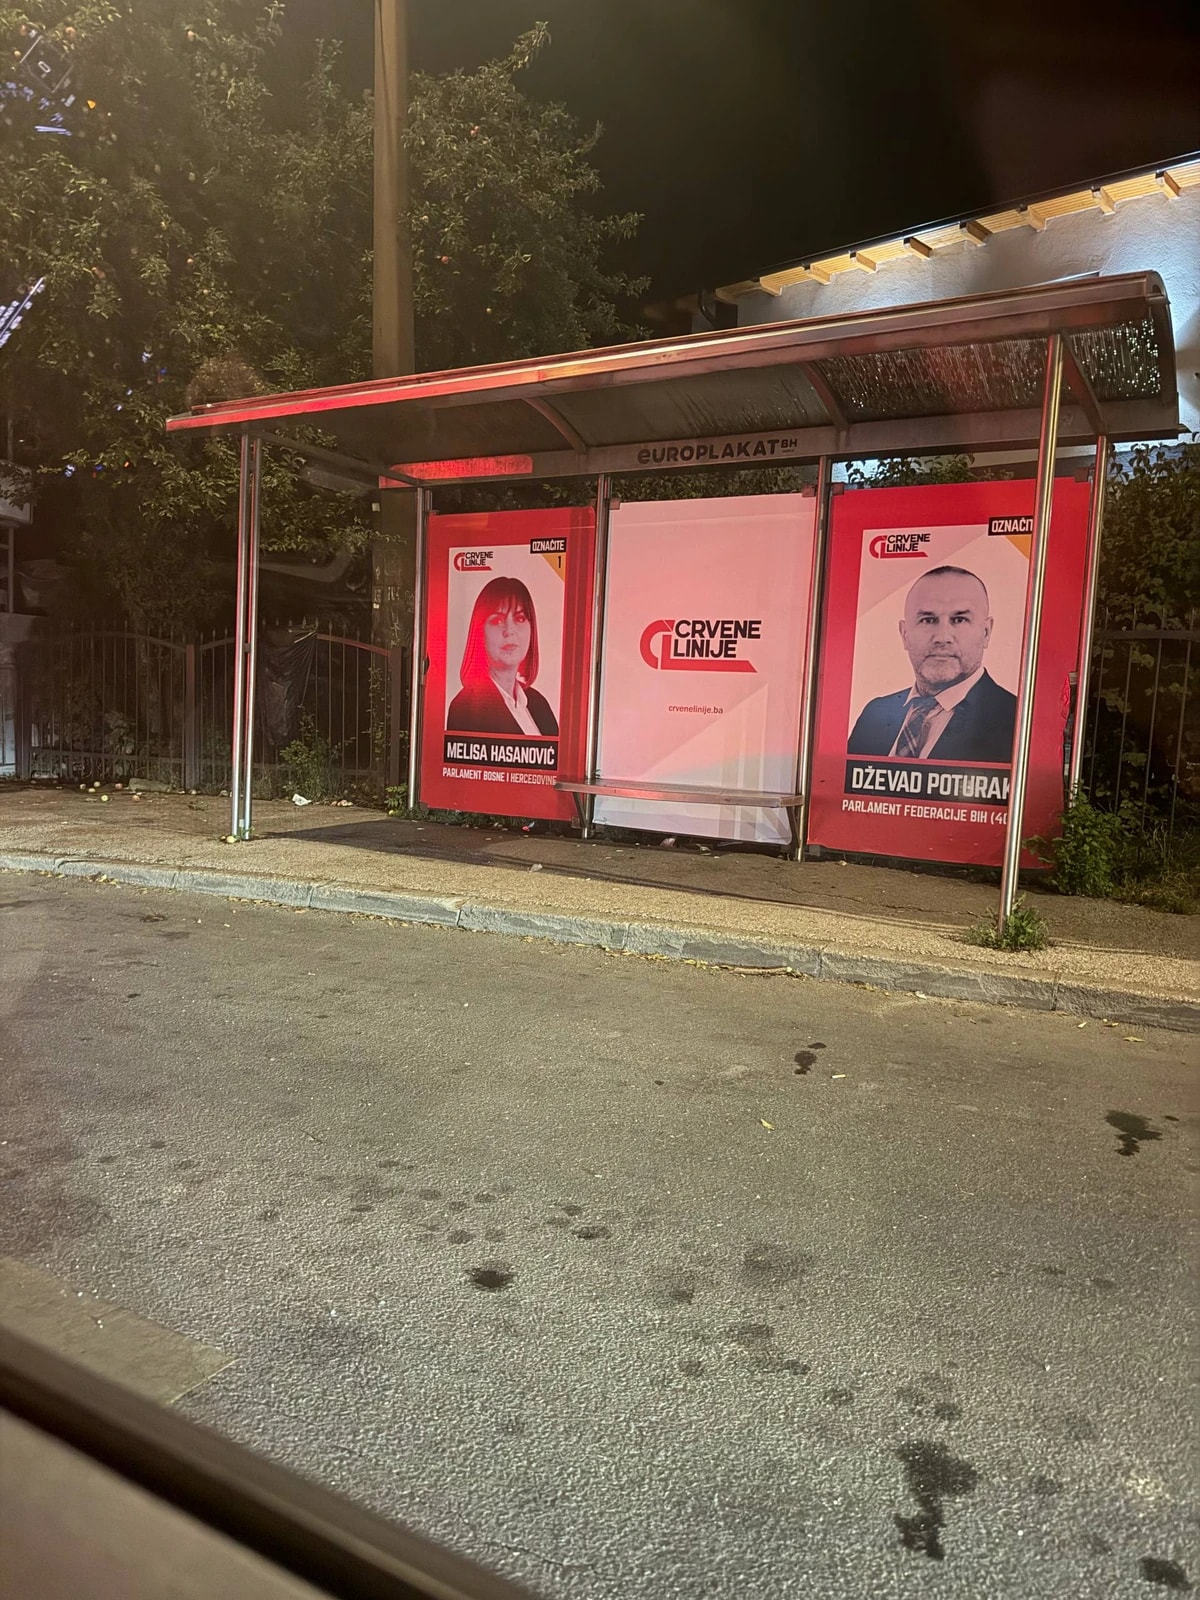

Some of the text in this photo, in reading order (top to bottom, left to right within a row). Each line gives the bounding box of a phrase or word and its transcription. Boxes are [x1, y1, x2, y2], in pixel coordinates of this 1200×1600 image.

[780, 438, 798, 449] BH
[991, 517, 1033, 533] OZNAČIT
[532, 539, 565, 551] OZNAČITE
[887, 533, 931, 543] CRVENE
[886, 542, 919, 552] LINIJE
[465, 551, 494, 559] CRVENE
[557, 556, 562, 569] 1
[675, 619, 762, 639] CRVENE
[673, 639, 737, 658] LINIJE
[668, 704, 724, 715] crvenelinije.ba
[446, 742, 555, 765] MELISA HASANOVIĆ
[442, 767, 557, 785] PARLAMENT BOSNE I HERCEGOVINE
[851, 765, 922, 794] DŽEVAD
[842, 799, 902, 816] PARLAMENT
[904, 804, 967, 821] FEDERACIJE
[969, 809, 988, 824] BIH
